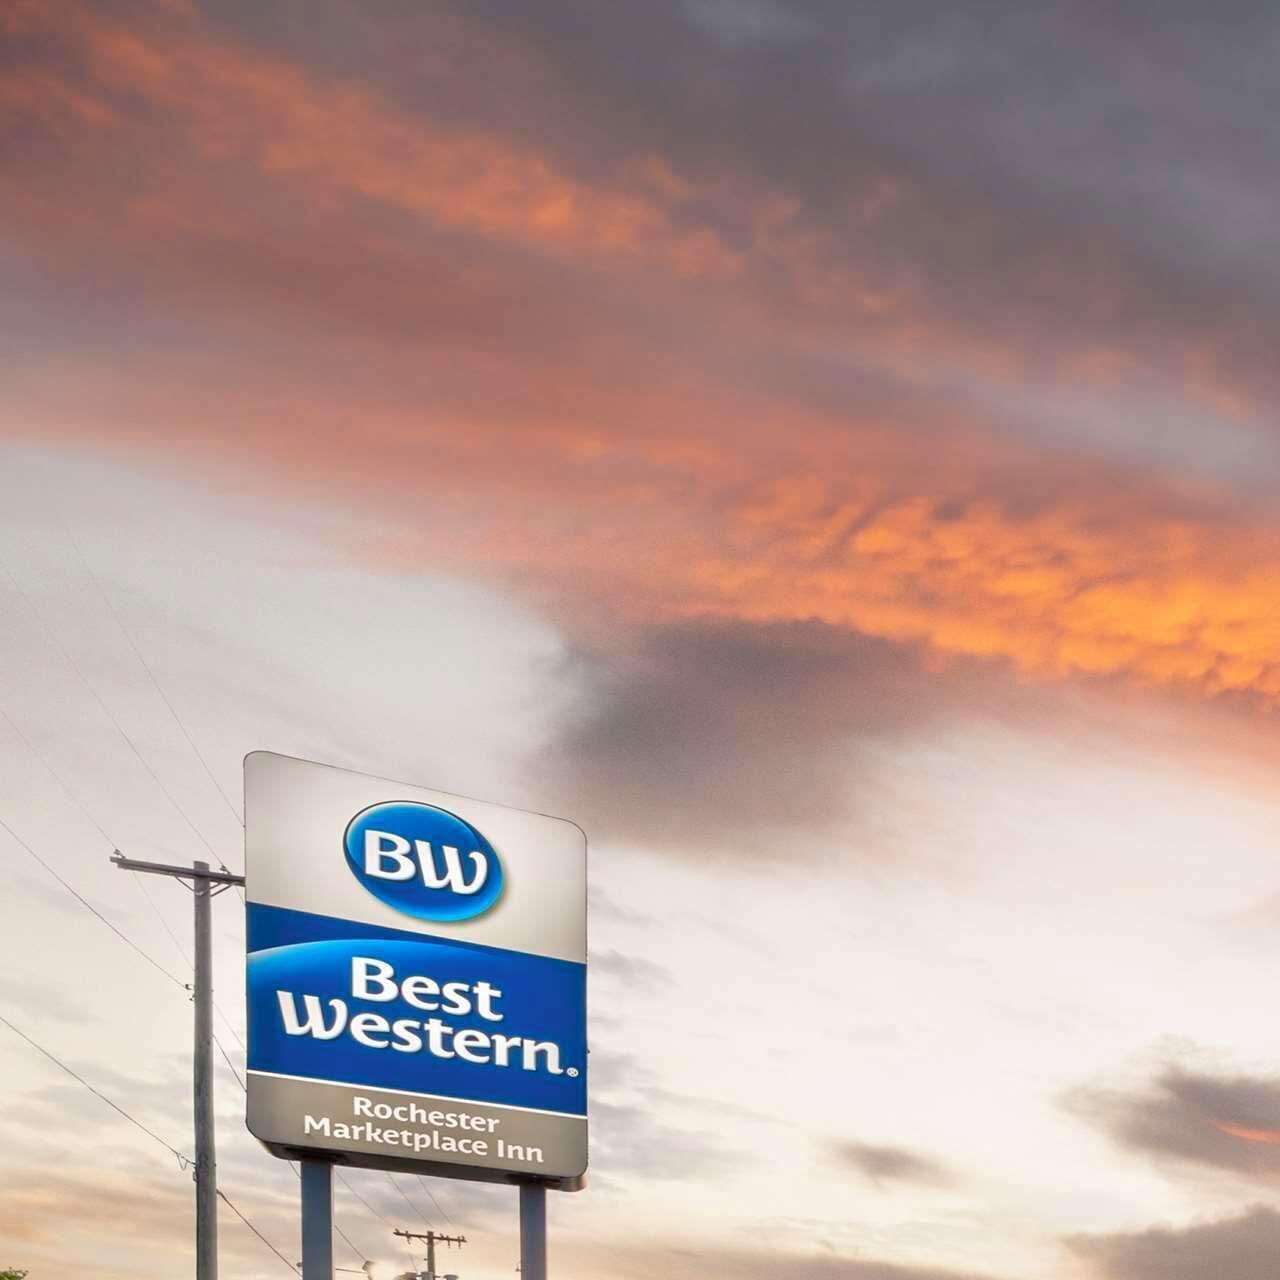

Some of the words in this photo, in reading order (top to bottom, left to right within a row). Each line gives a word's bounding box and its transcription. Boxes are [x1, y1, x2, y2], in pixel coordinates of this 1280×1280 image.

[364, 829, 489, 895] BW
[352, 956, 503, 1021] Best
[303, 1115, 488, 1156] Marketplace
[497, 1139, 544, 1163] Inn
[353, 1096, 500, 1133] Rochester
